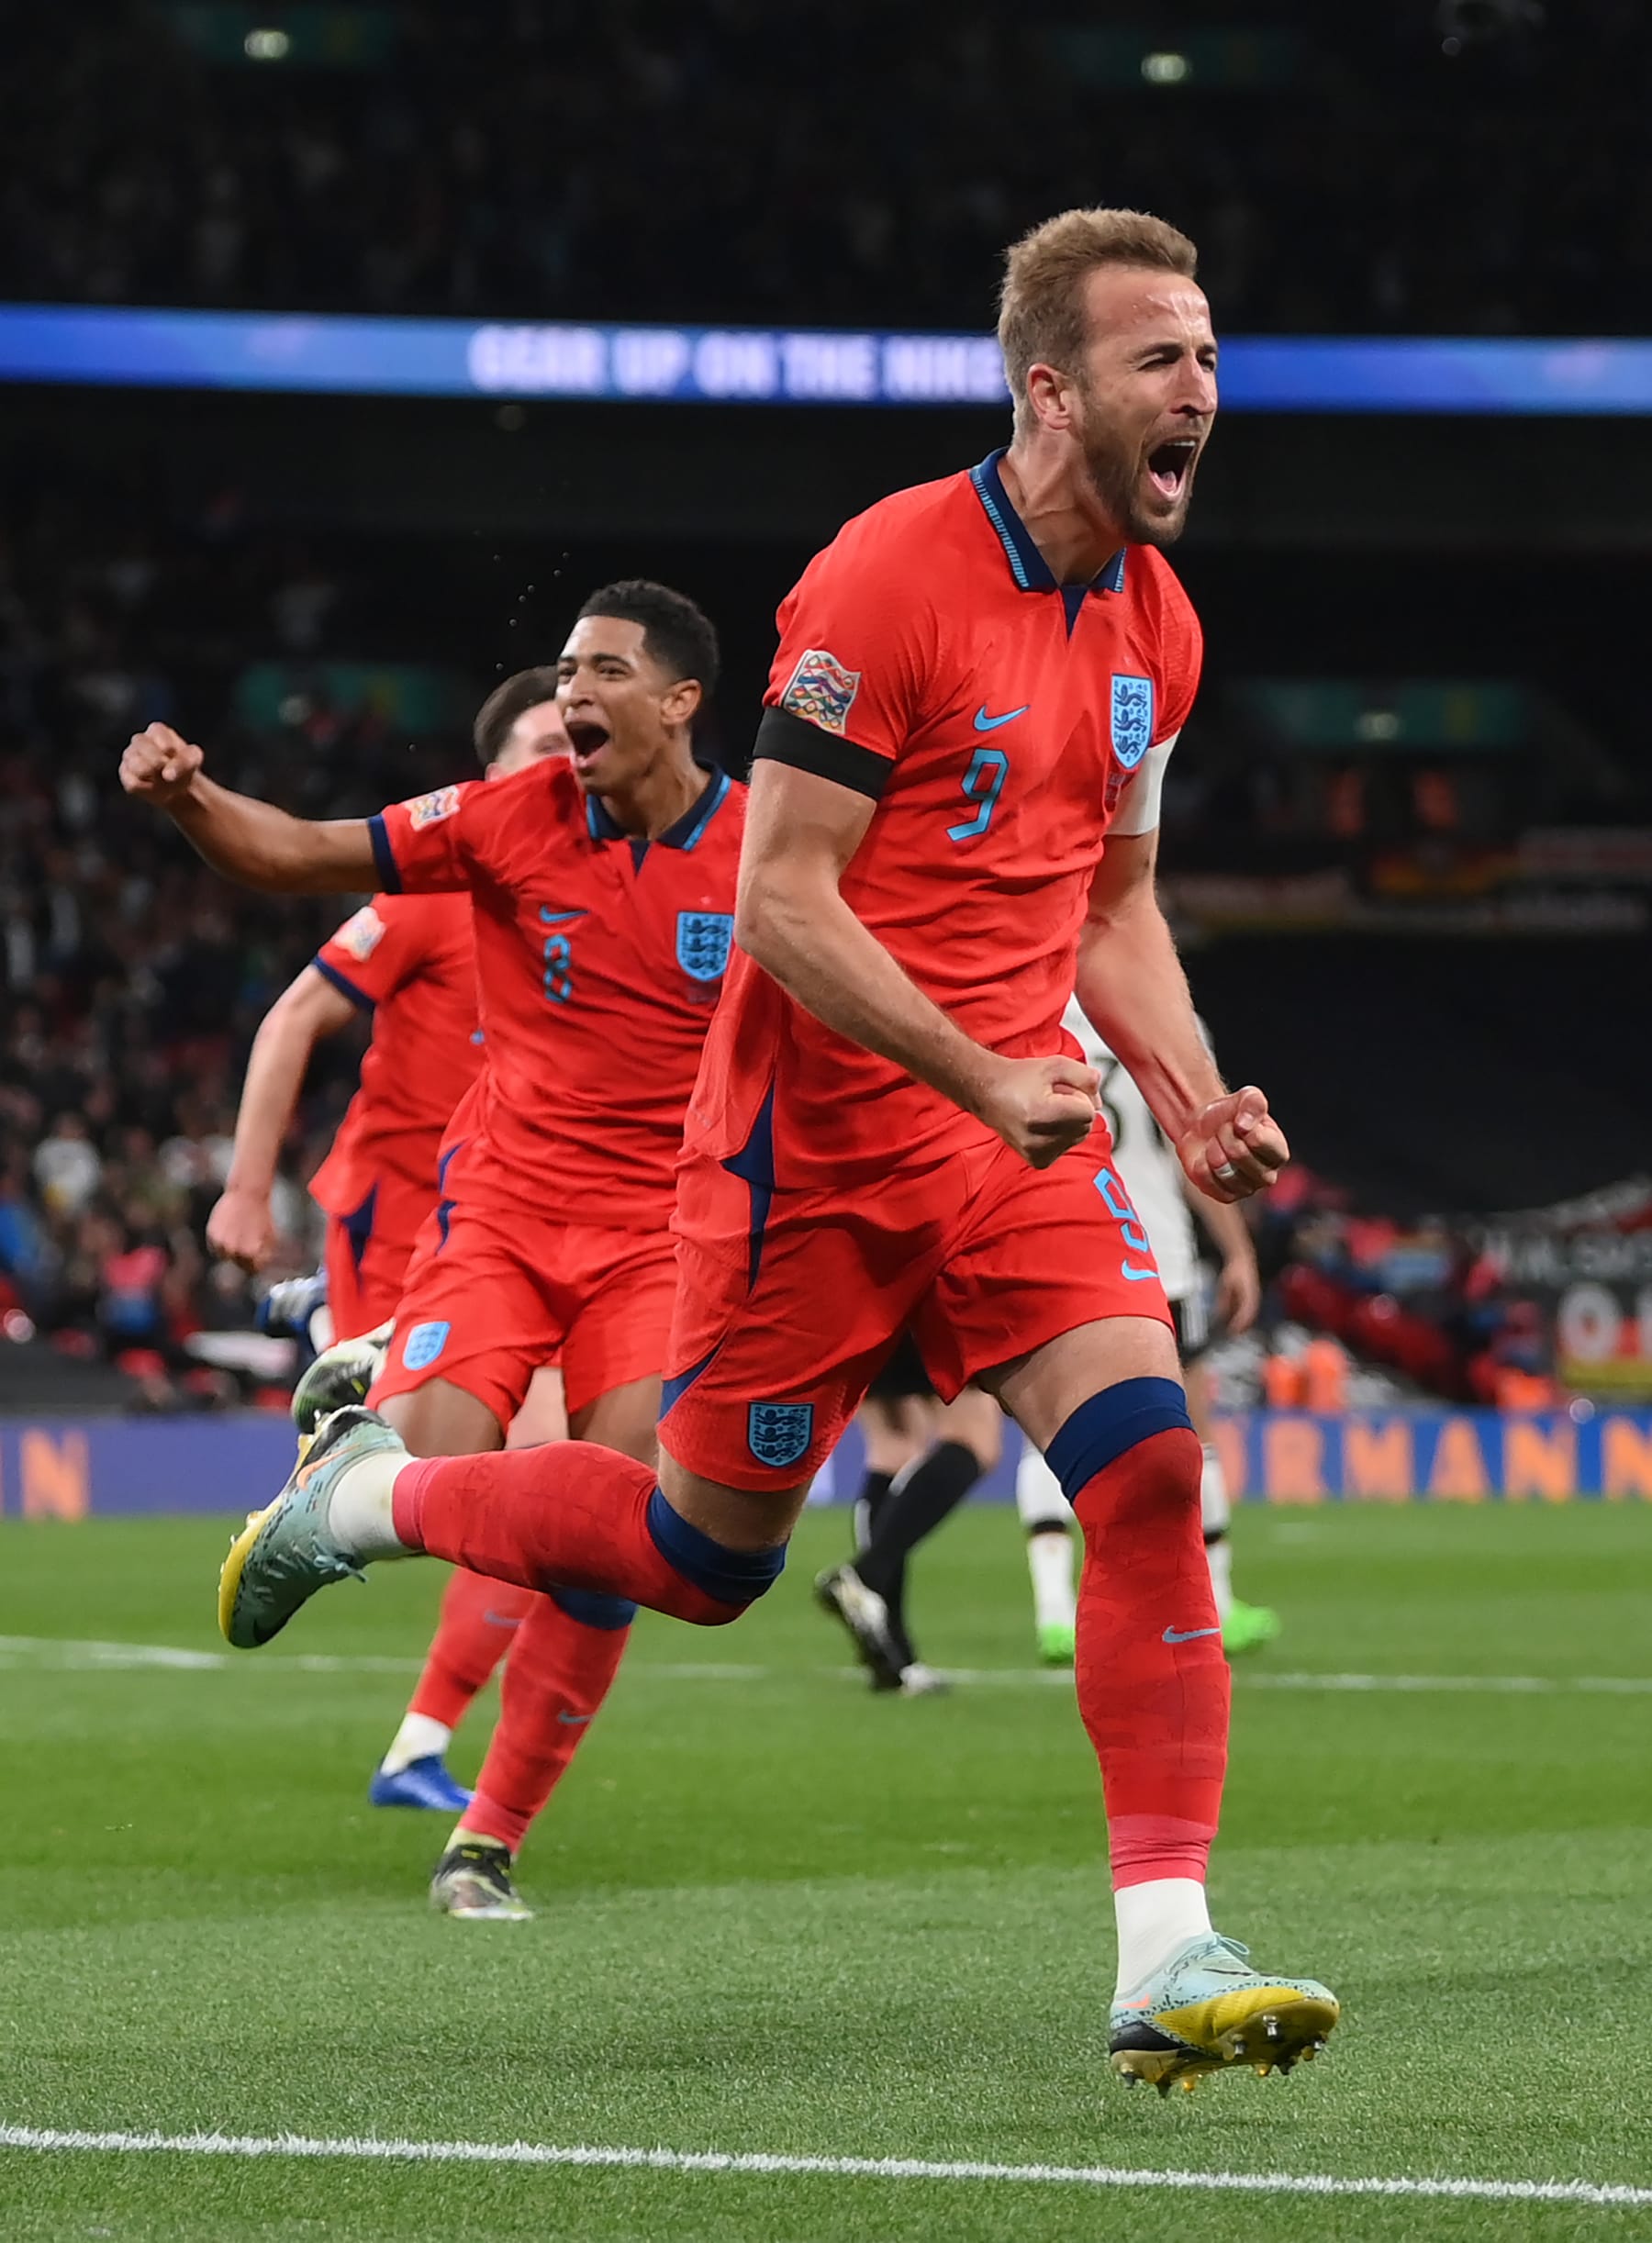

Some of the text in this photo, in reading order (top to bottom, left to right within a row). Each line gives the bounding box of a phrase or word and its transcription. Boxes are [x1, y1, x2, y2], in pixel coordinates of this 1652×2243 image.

[471, 326, 1006, 402] GEAR UP ON THE NIKE
[946, 747, 1010, 843] 9
[543, 932, 574, 1004] 8
[1093, 1166, 1150, 1253] 9
[0, 1428, 90, 1523] N
